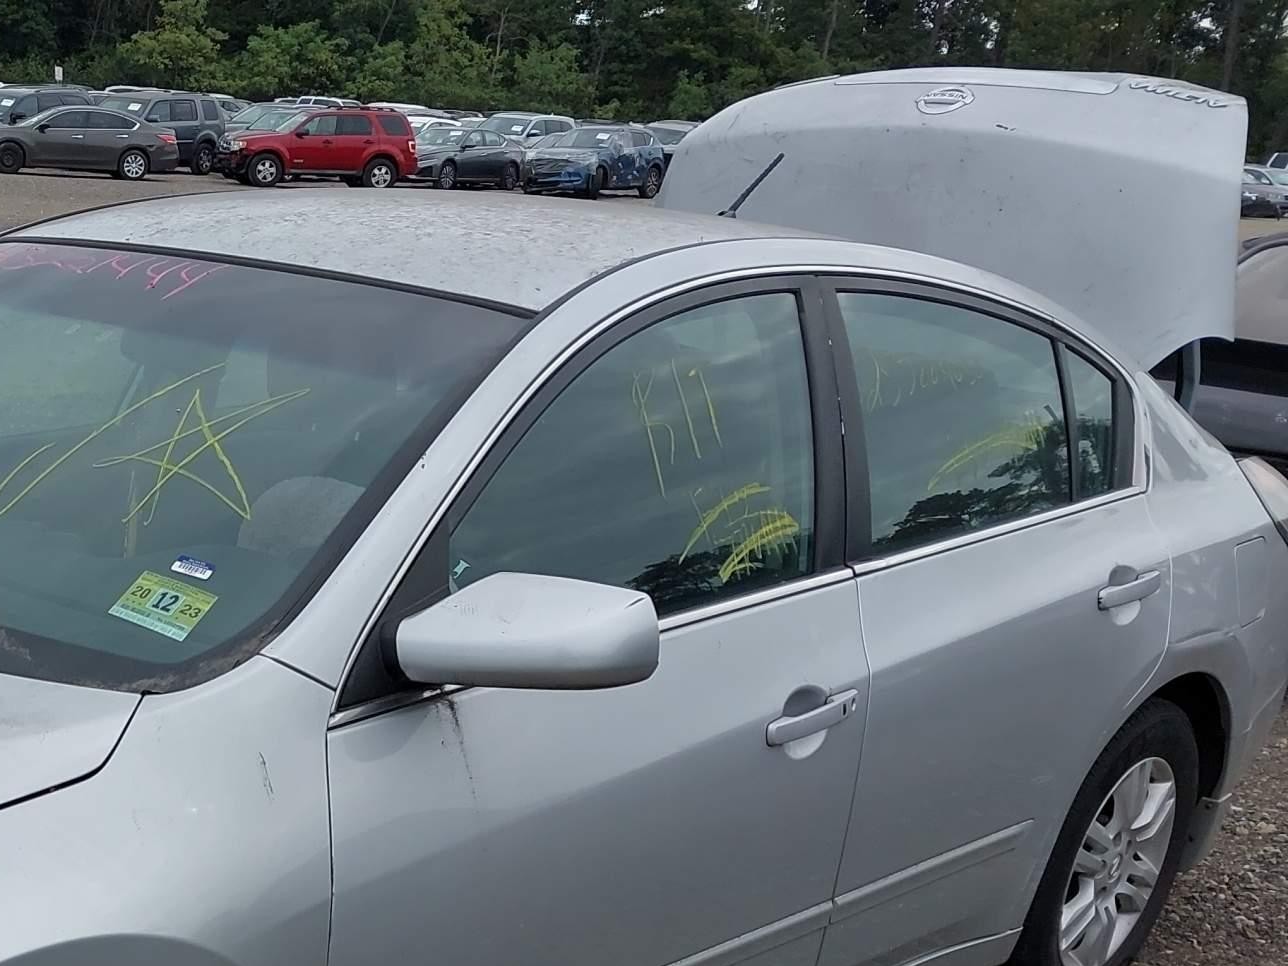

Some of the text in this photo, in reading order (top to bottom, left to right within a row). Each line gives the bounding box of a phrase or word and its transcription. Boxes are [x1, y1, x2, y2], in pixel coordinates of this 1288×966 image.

[130, 585, 152, 600] 20
[151, 591, 180, 613] 12
[179, 604, 202, 619] 23
